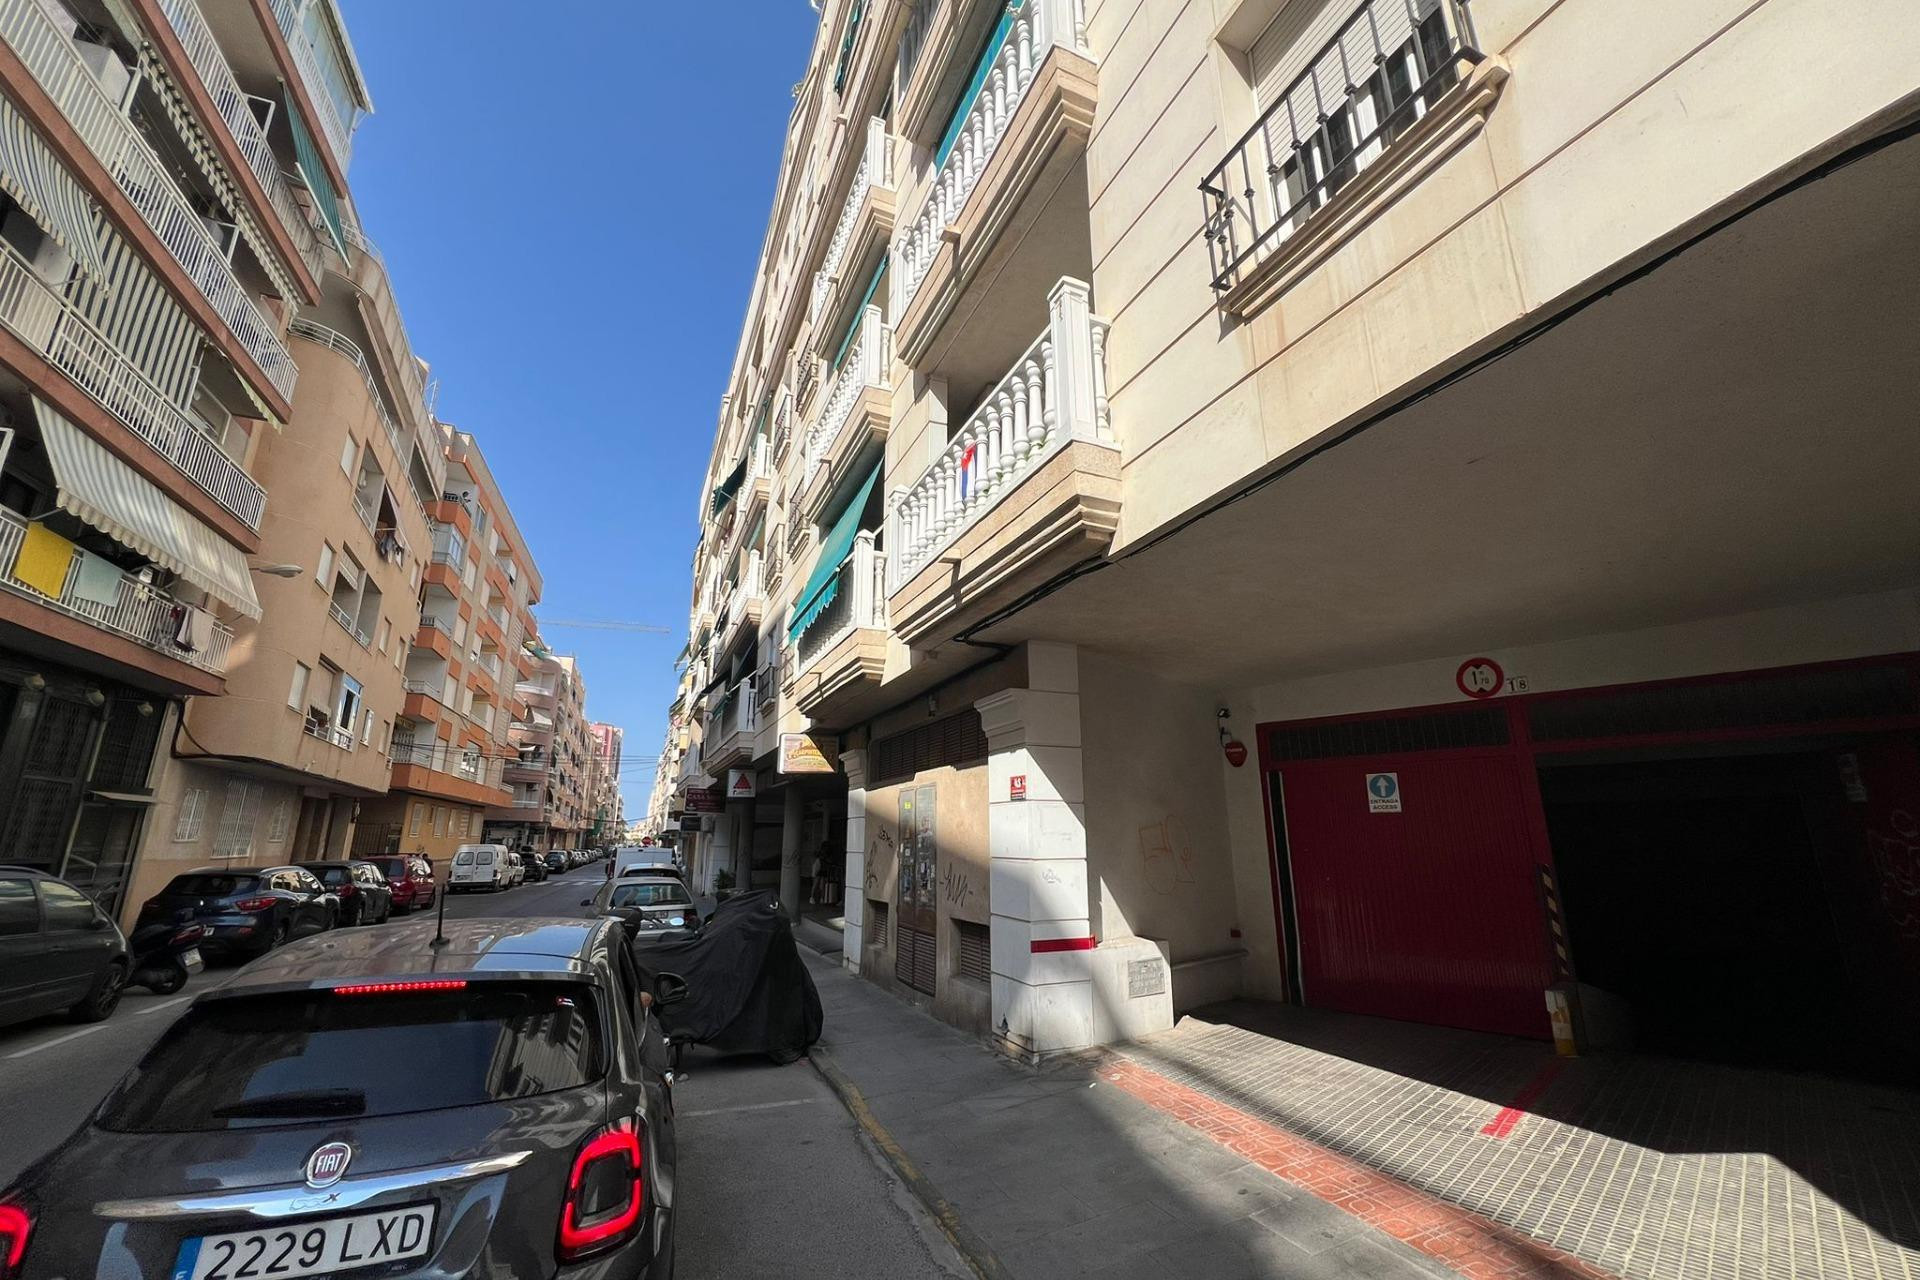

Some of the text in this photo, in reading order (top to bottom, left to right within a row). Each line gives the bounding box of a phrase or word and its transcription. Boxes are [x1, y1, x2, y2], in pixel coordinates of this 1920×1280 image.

[315, 1153, 343, 1174] FIAT
[204, 1213, 424, 1280] 2229 LXD
